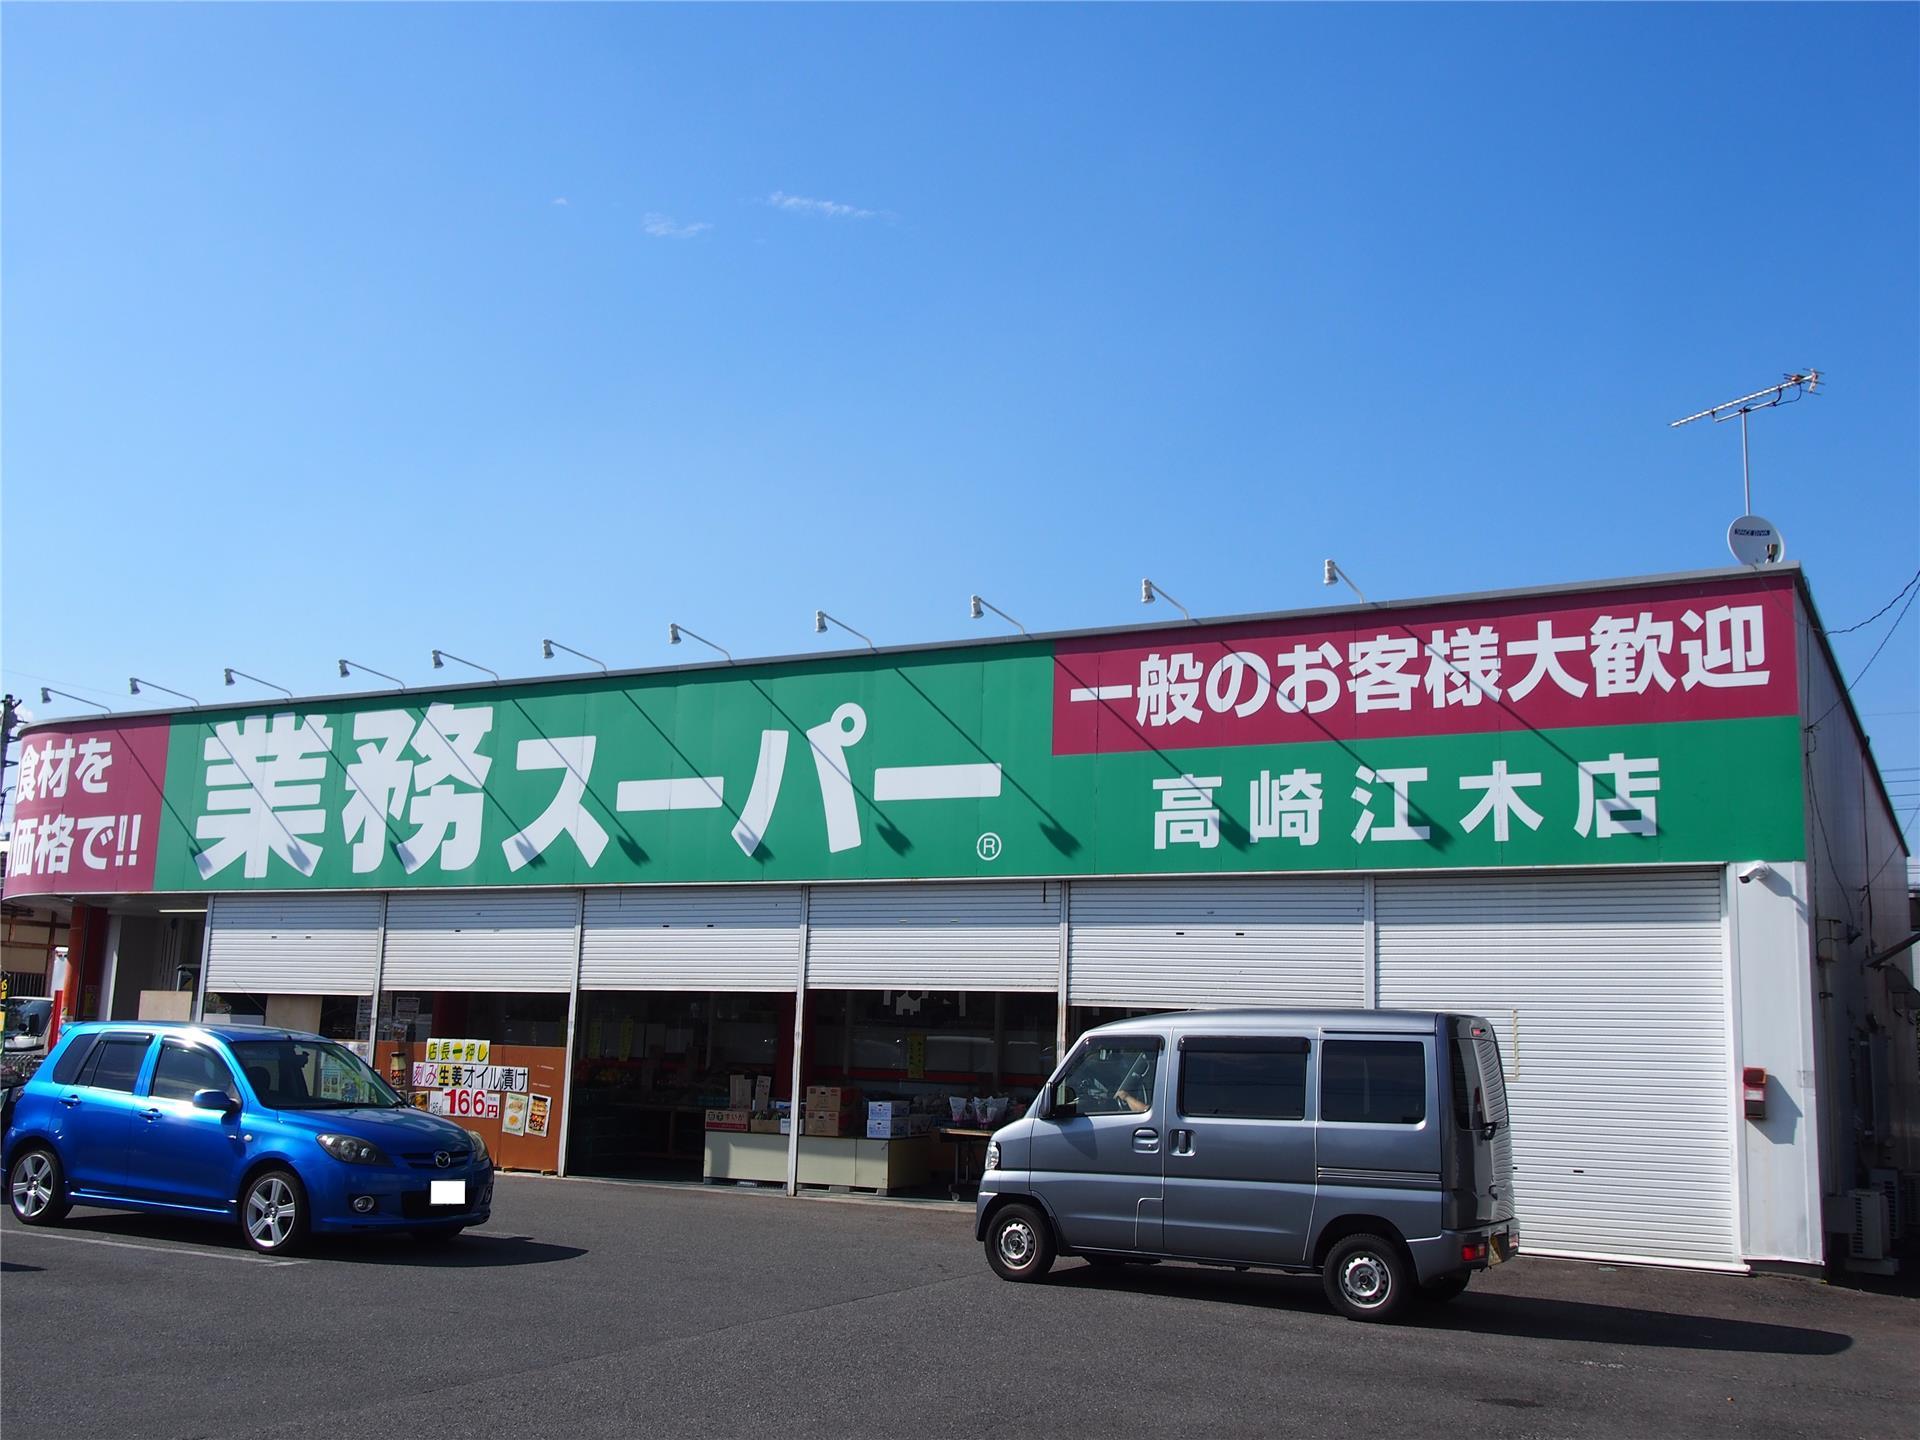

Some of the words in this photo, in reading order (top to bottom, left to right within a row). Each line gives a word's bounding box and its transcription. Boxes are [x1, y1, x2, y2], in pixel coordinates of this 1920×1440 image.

[1070, 605, 1769, 727] 一般のお客様大歓迎
[17, 738, 112, 804] 食材を
[194, 702, 1002, 880] 業務スーパー
[1152, 752, 1660, 850] 高崎江木店
[5, 814, 142, 878] 価格で!!
[412, 1064, 527, 1091] 刻み生姜オイル漬け
[427, 1041, 488, 1062] 店長一押し
[444, 1089, 498, 1117] 166円
